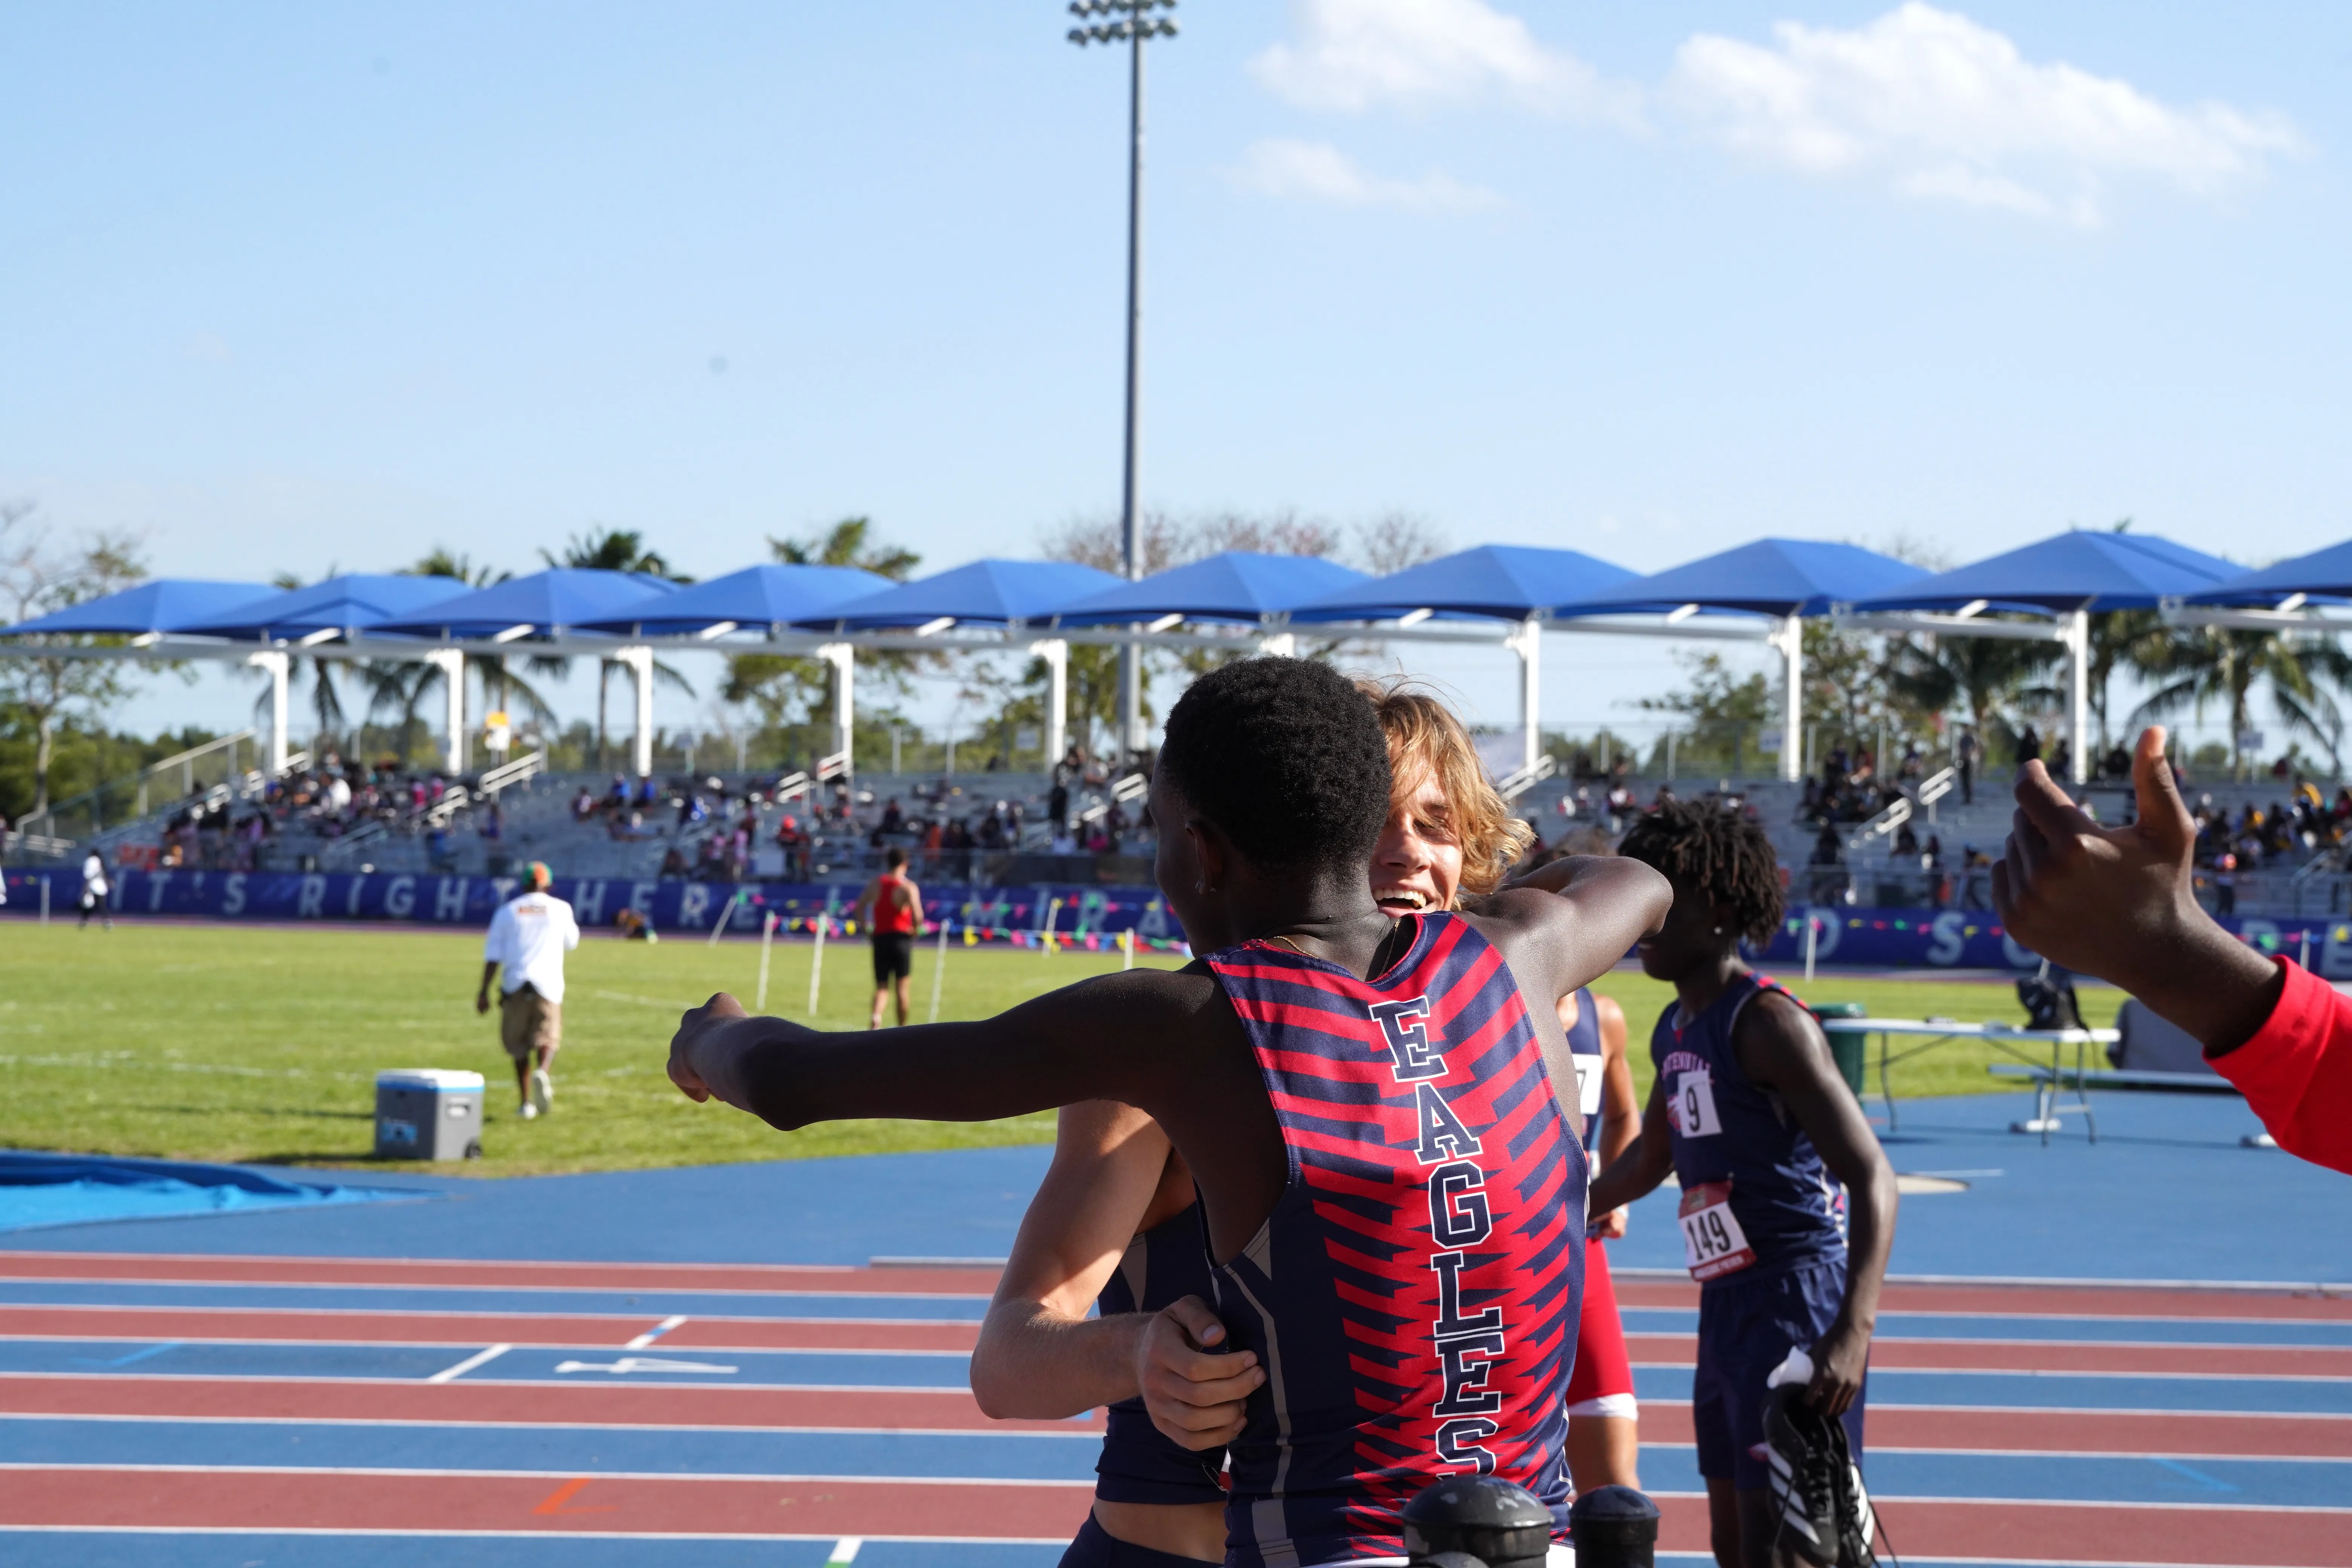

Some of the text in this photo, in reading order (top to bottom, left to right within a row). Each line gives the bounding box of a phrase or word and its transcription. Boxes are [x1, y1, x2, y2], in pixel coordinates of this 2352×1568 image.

[1686, 1086, 1700, 1132] 9
[1369, 995, 1505, 1480] EAGLES
[1687, 1210, 1731, 1261] 149
